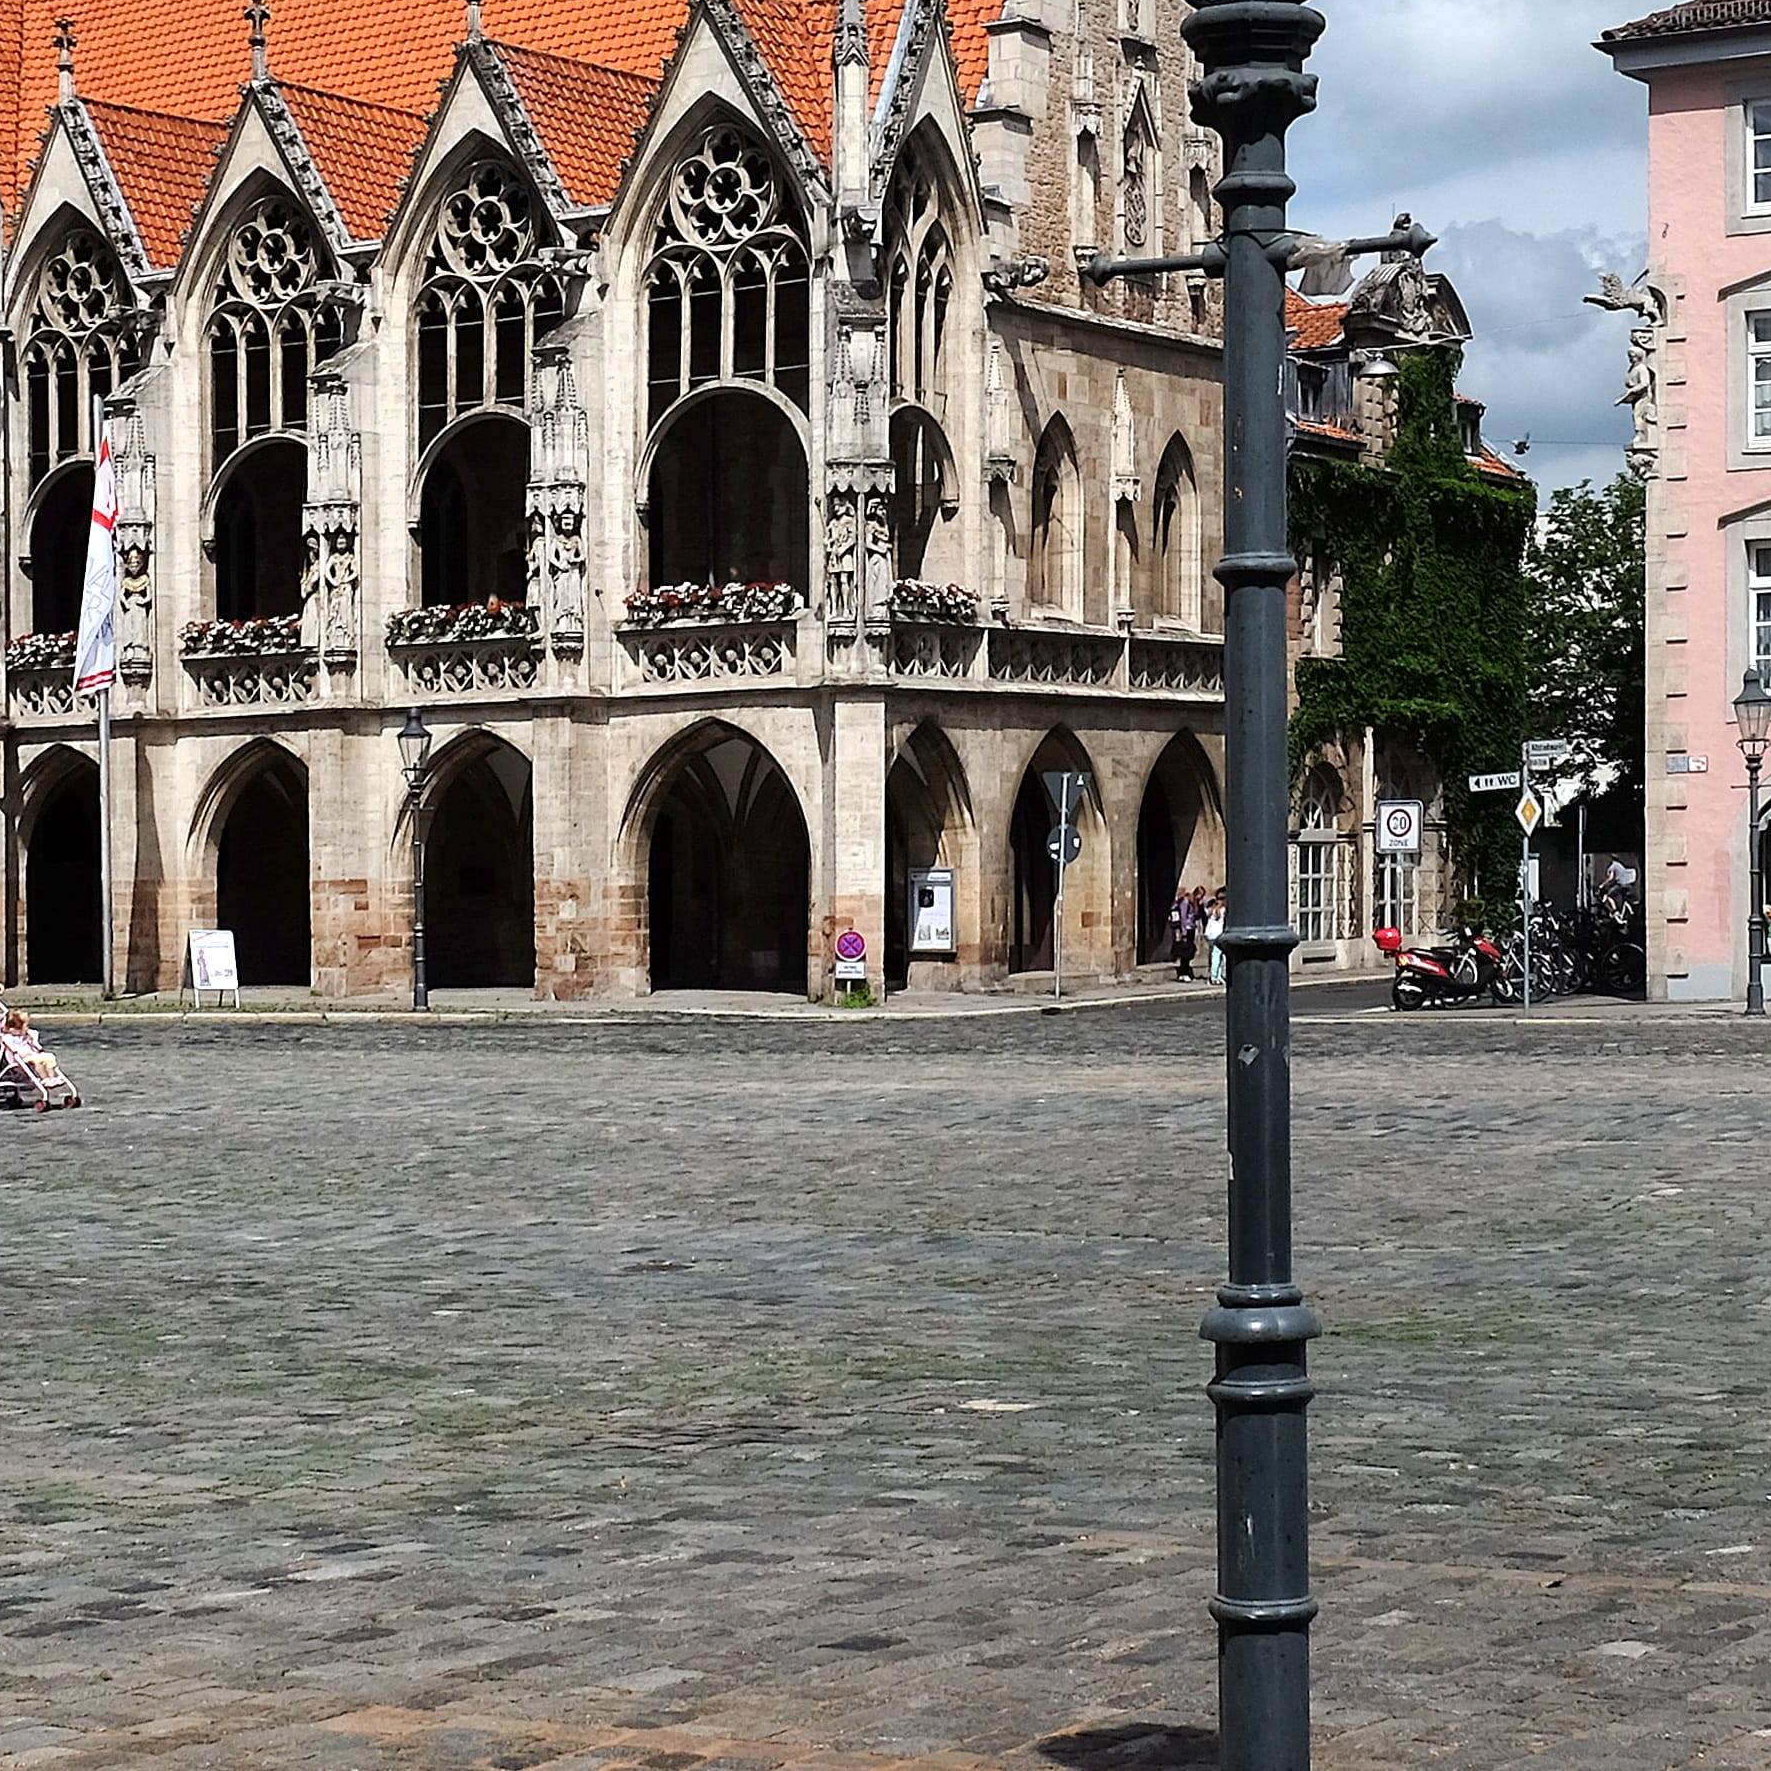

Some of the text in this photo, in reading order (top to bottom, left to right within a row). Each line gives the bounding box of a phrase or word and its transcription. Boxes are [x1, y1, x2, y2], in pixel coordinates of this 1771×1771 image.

[1497, 774, 1517, 786] WC
[1392, 816, 1407, 830] 30
[1388, 839, 1409, 847] ZONE
